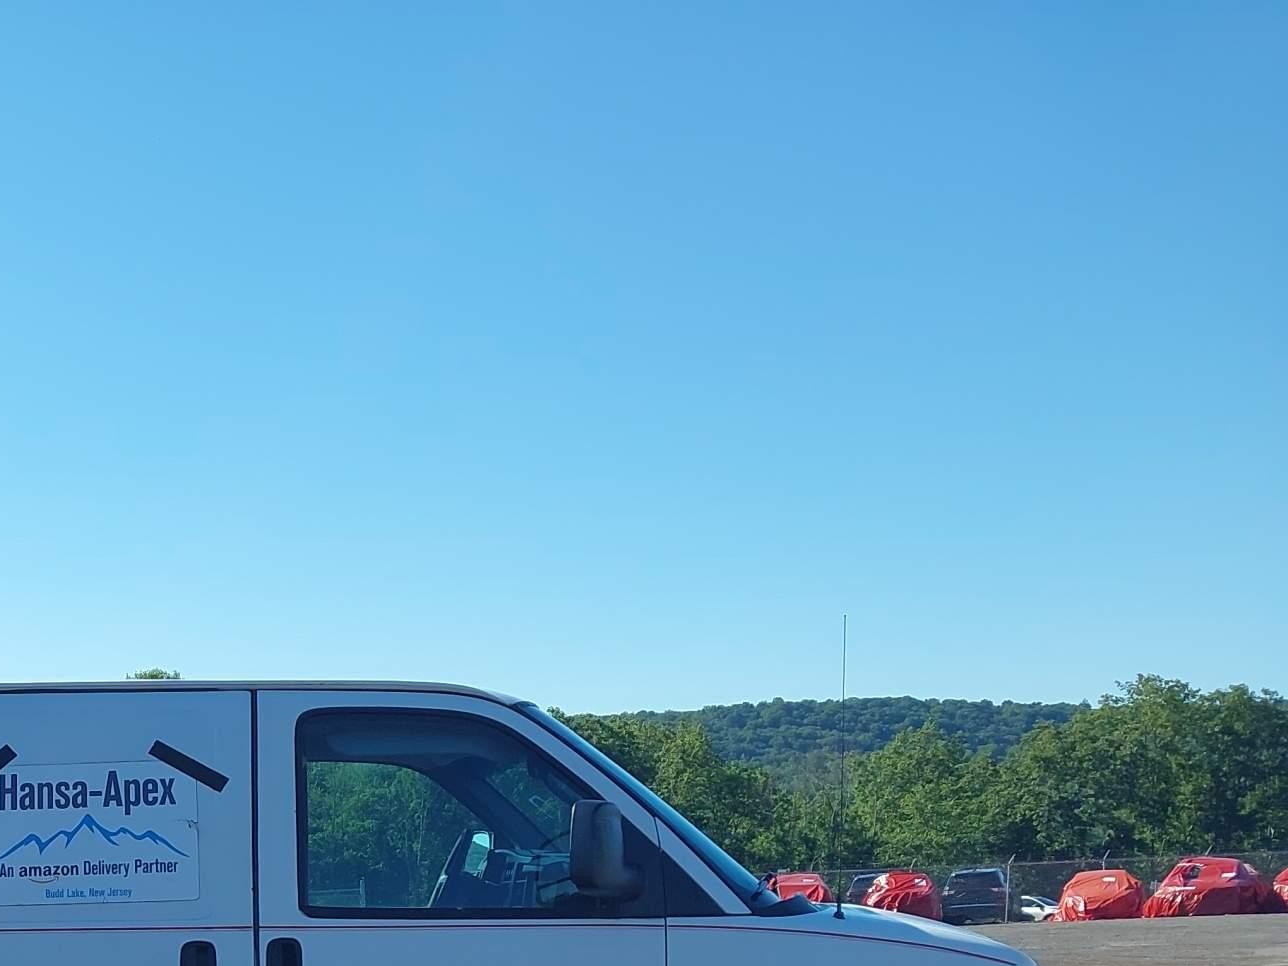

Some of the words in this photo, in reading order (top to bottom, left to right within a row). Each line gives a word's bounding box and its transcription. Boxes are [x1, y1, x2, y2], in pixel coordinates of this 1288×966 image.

[0, 770, 176, 816] Hansa-Apex
[0, 863, 14, 878] An
[19, 864, 79, 878] amazon
[83, 860, 130, 878] Delivery
[134, 858, 178, 873] Partner
[45, 888, 64, 898] Budd
[89, 888, 105, 897] New
[107, 887, 133, 898] Jersey
